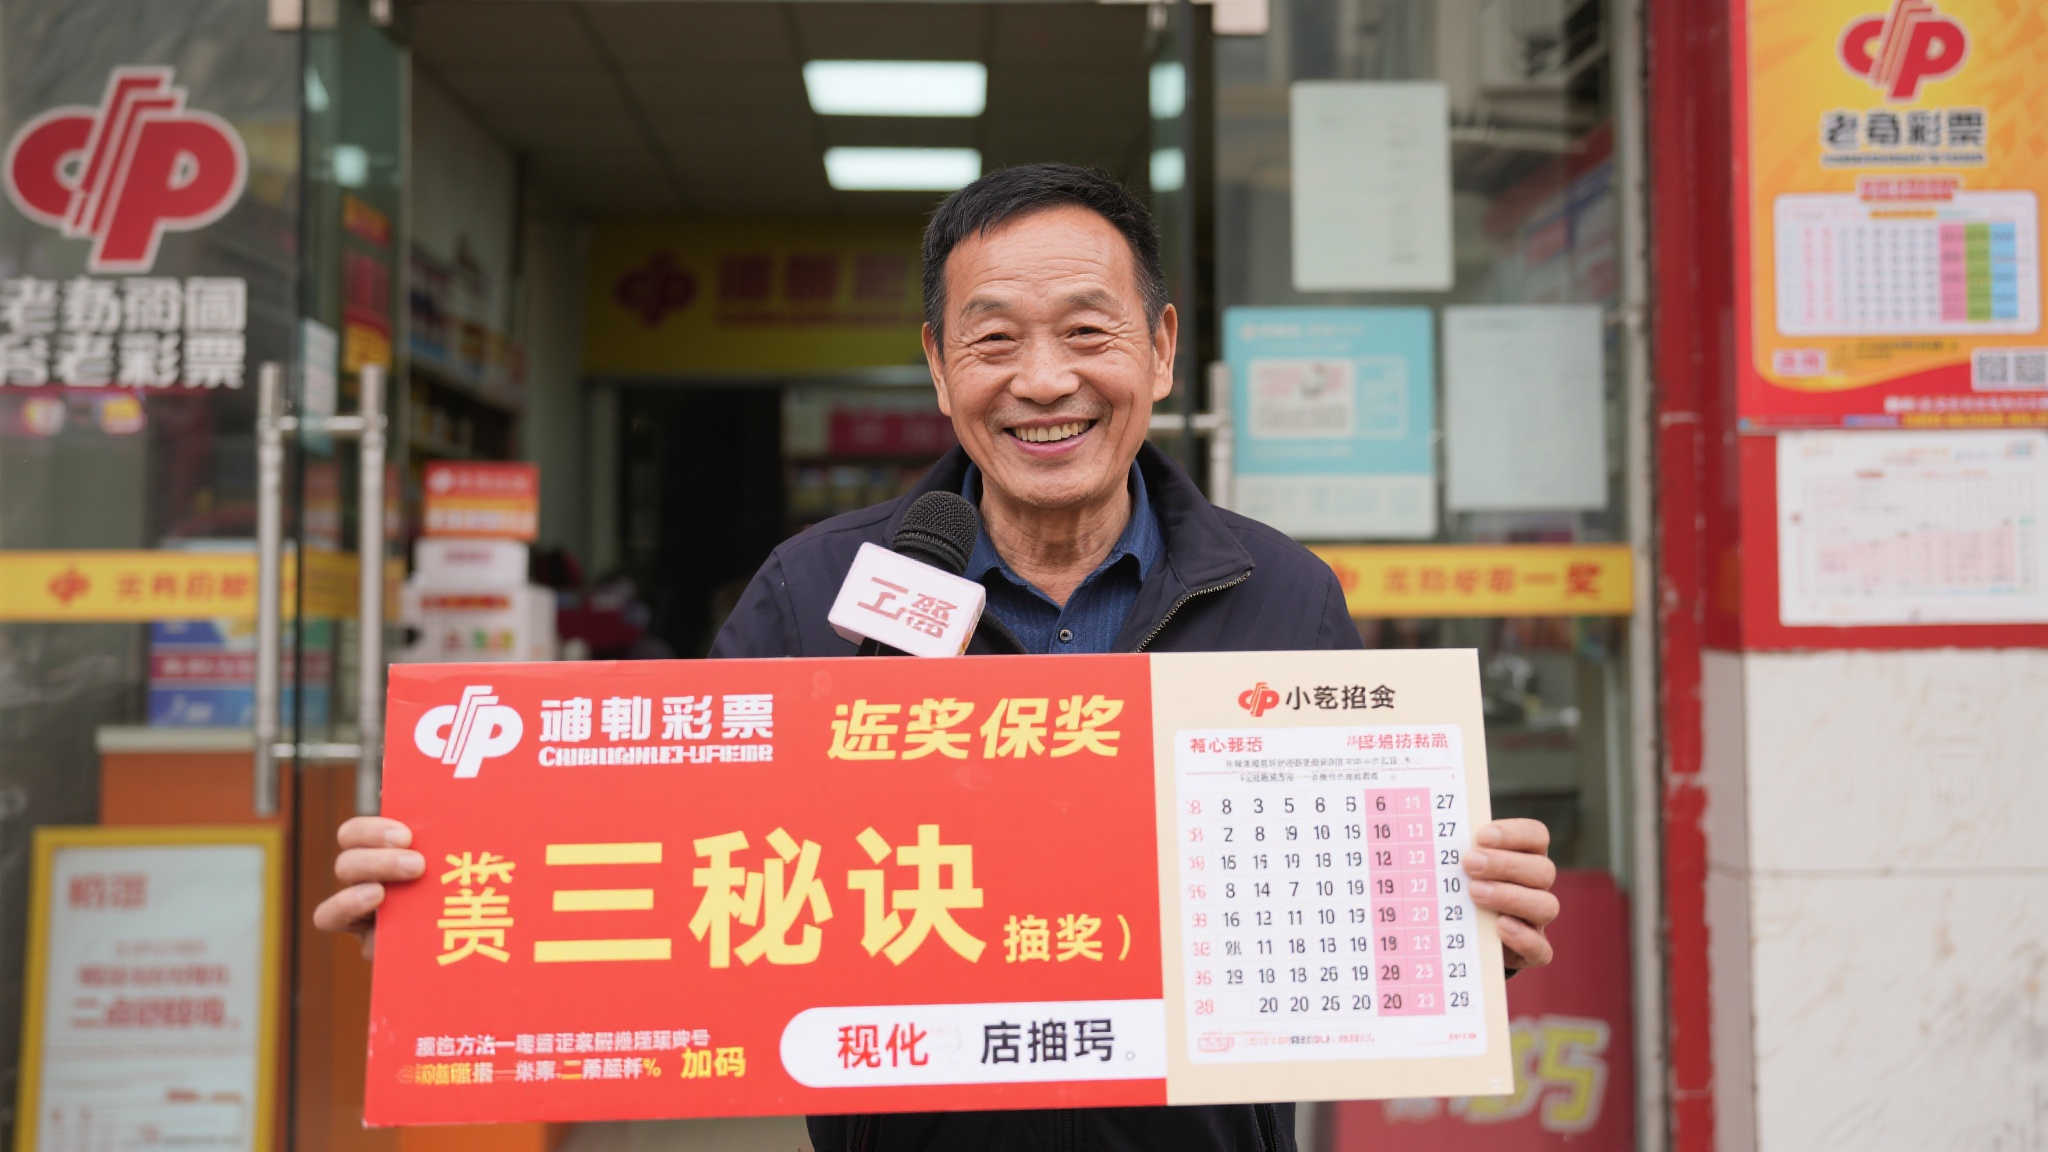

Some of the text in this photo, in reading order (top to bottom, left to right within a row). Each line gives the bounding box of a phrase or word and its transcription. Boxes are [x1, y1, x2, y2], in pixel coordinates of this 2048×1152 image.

[1222, 799, 1232, 815] 8
[1253, 798, 1263, 813] 3
[1284, 798, 1294, 813] 5
[1437, 794, 1454, 809] 27
[1255, 826, 1265, 842] 8
[1438, 822, 1456, 837] 27
[1441, 850, 1459, 865] 29
[533, 824, 988, 969] 三秘诀
[1226, 883, 1235, 899] 8
[1254, 882, 1270, 897] 14
[1289, 881, 1299, 896] 7
[1316, 881, 1333, 896] 10
[1443, 878, 1460, 893] 10
[1224, 912, 1240, 927] 16
[1288, 910, 1302, 925] 11
[1318, 909, 1335, 925] 10
[1257, 939, 1272, 954] 11
[1260, 997, 1278, 1013] 20
[1290, 996, 1309, 1012] 20
[1383, 994, 1402, 1009] 20
[680, 1045, 747, 1080] 加码
